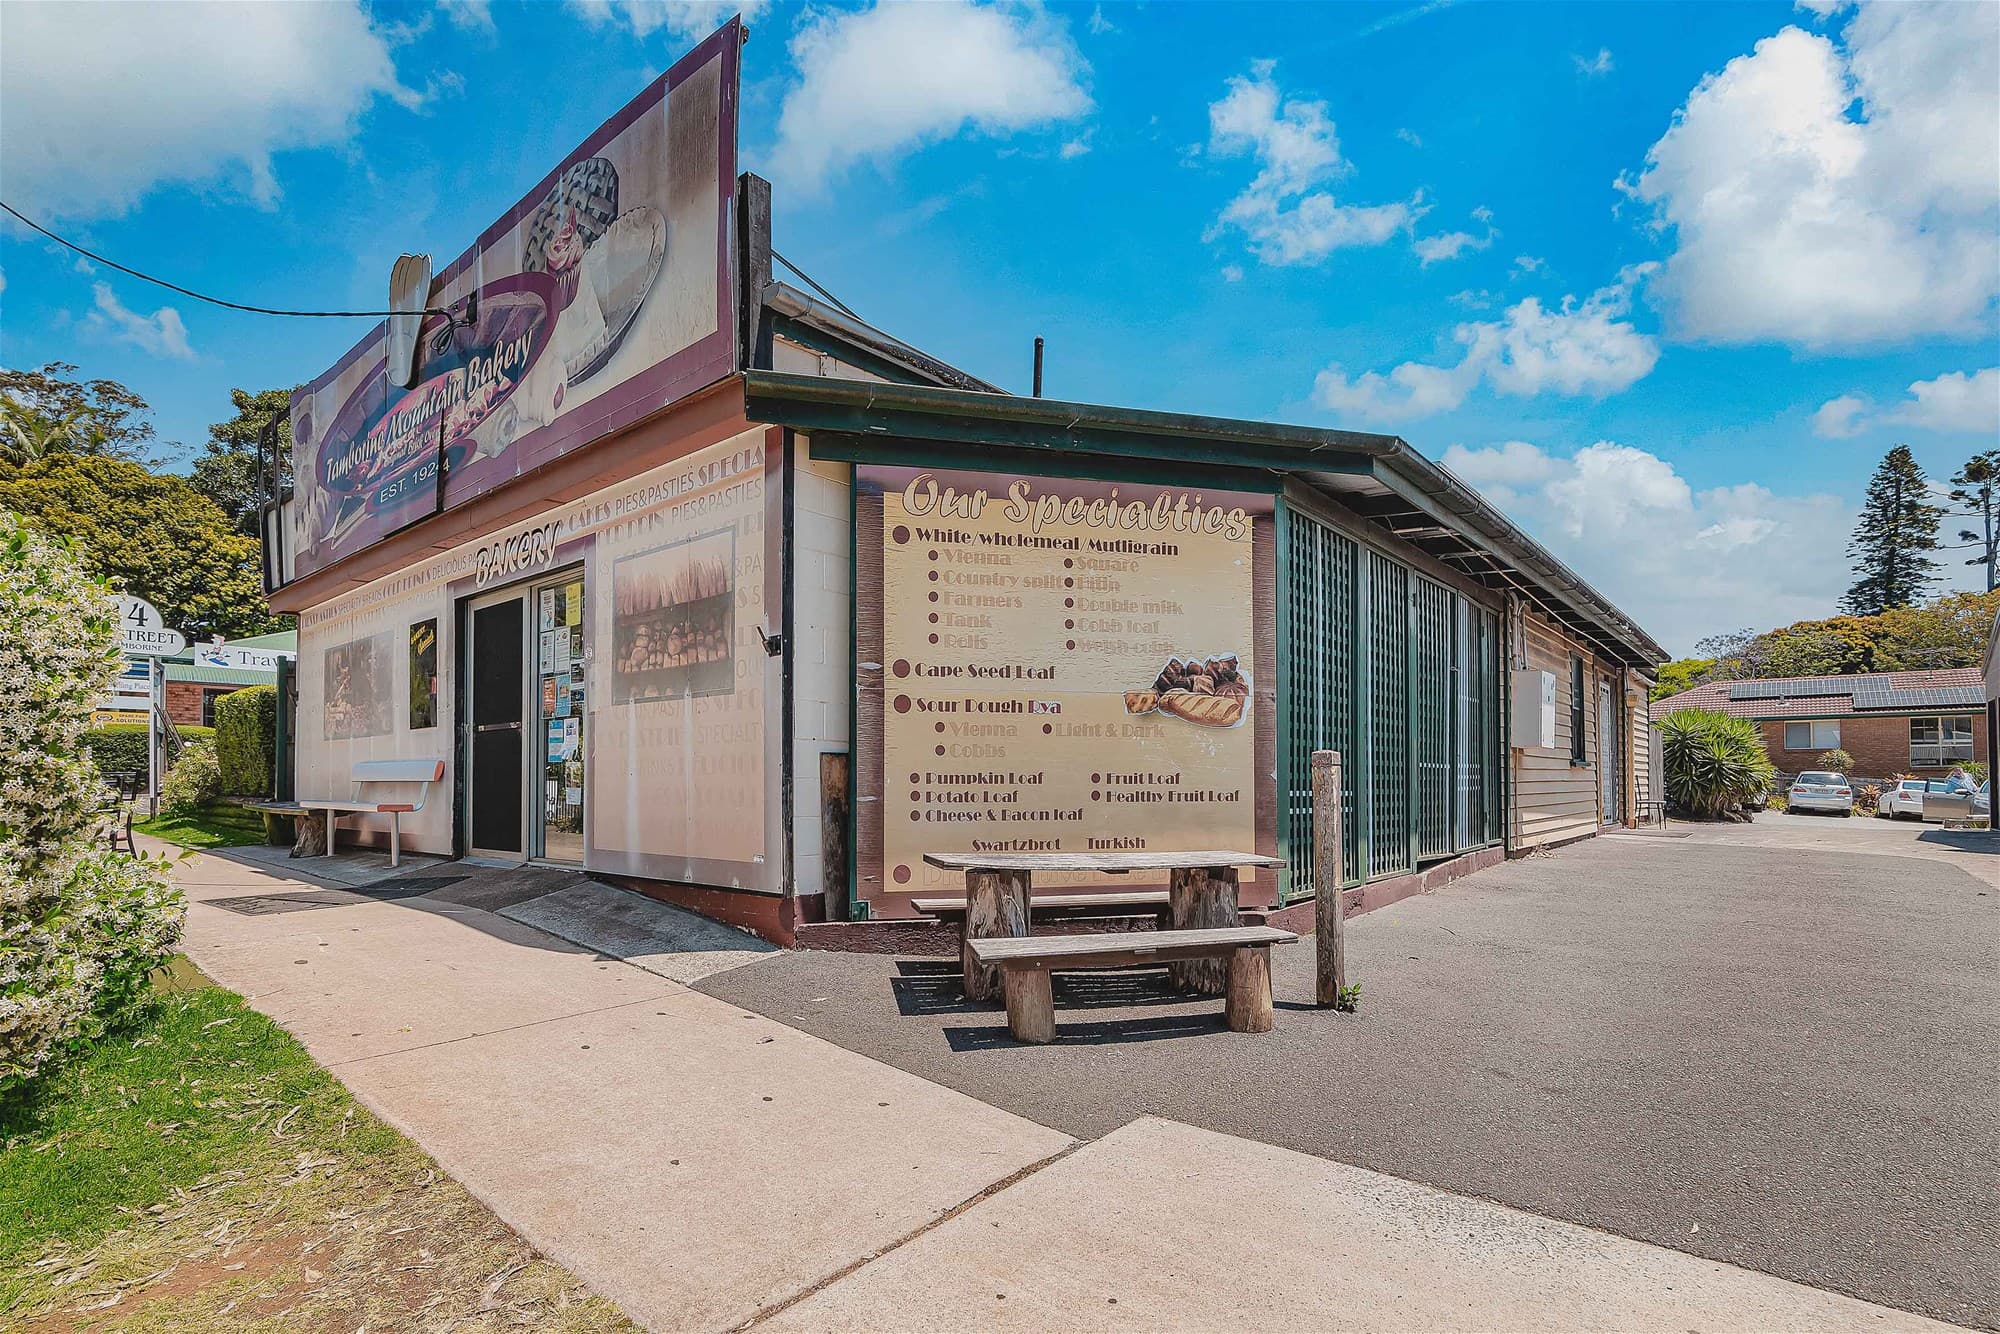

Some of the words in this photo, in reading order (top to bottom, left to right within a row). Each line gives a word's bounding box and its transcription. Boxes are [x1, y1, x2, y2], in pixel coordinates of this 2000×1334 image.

[386, 372, 464, 446] Mountain
[467, 328, 534, 398] Bakery
[380, 478, 408, 503] EST.
[901, 472, 989, 519] Our
[568, 500, 612, 532] CAKES
[942, 549, 1013, 566] Vienna
[1076, 556, 1139, 573] Square
[431, 553, 466, 580] DELICIOUS
[942, 570, 1020, 588] Country
[943, 591, 1023, 608] Farmers
[1076, 597, 1139, 614] Double
[1142, 599, 1184, 615] milk
[127, 602, 148, 628] 4
[942, 612, 993, 628] Tank
[124, 628, 178, 645] TREET
[121, 643, 163, 652] MBORINE
[914, 661, 963, 682] Cape
[966, 662, 1011, 679] Seed
[1015, 663, 1057, 680] Loaf
[916, 698, 960, 713] Sour
[964, 698, 1023, 714] Dough
[949, 721, 1018, 737] Vienna
[1055, 723, 1101, 738] Light
[1105, 723, 1118, 737] &
[1121, 723, 1166, 738] Dark
[949, 743, 1007, 758] Cobbs
[925, 771, 1005, 786] Pumpkin
[1008, 771, 1044, 785] Loaf
[1106, 772, 1145, 785] Fruit
[1148, 772, 1181, 785] Loaf
[925, 790, 979, 803] Potato
[983, 790, 1019, 803] Loaf
[1106, 790, 1165, 803] Healthy
[1168, 790, 1205, 802] Fruit
[1208, 789, 1240, 802] Loaf
[925, 808, 982, 822] Cheese
[985, 808, 997, 821] &
[1001, 808, 1050, 821] Bacon
[1053, 807, 1084, 821] loaf
[972, 838, 1061, 852] Swartzbrot
[1086, 836, 1146, 850] Turkish
